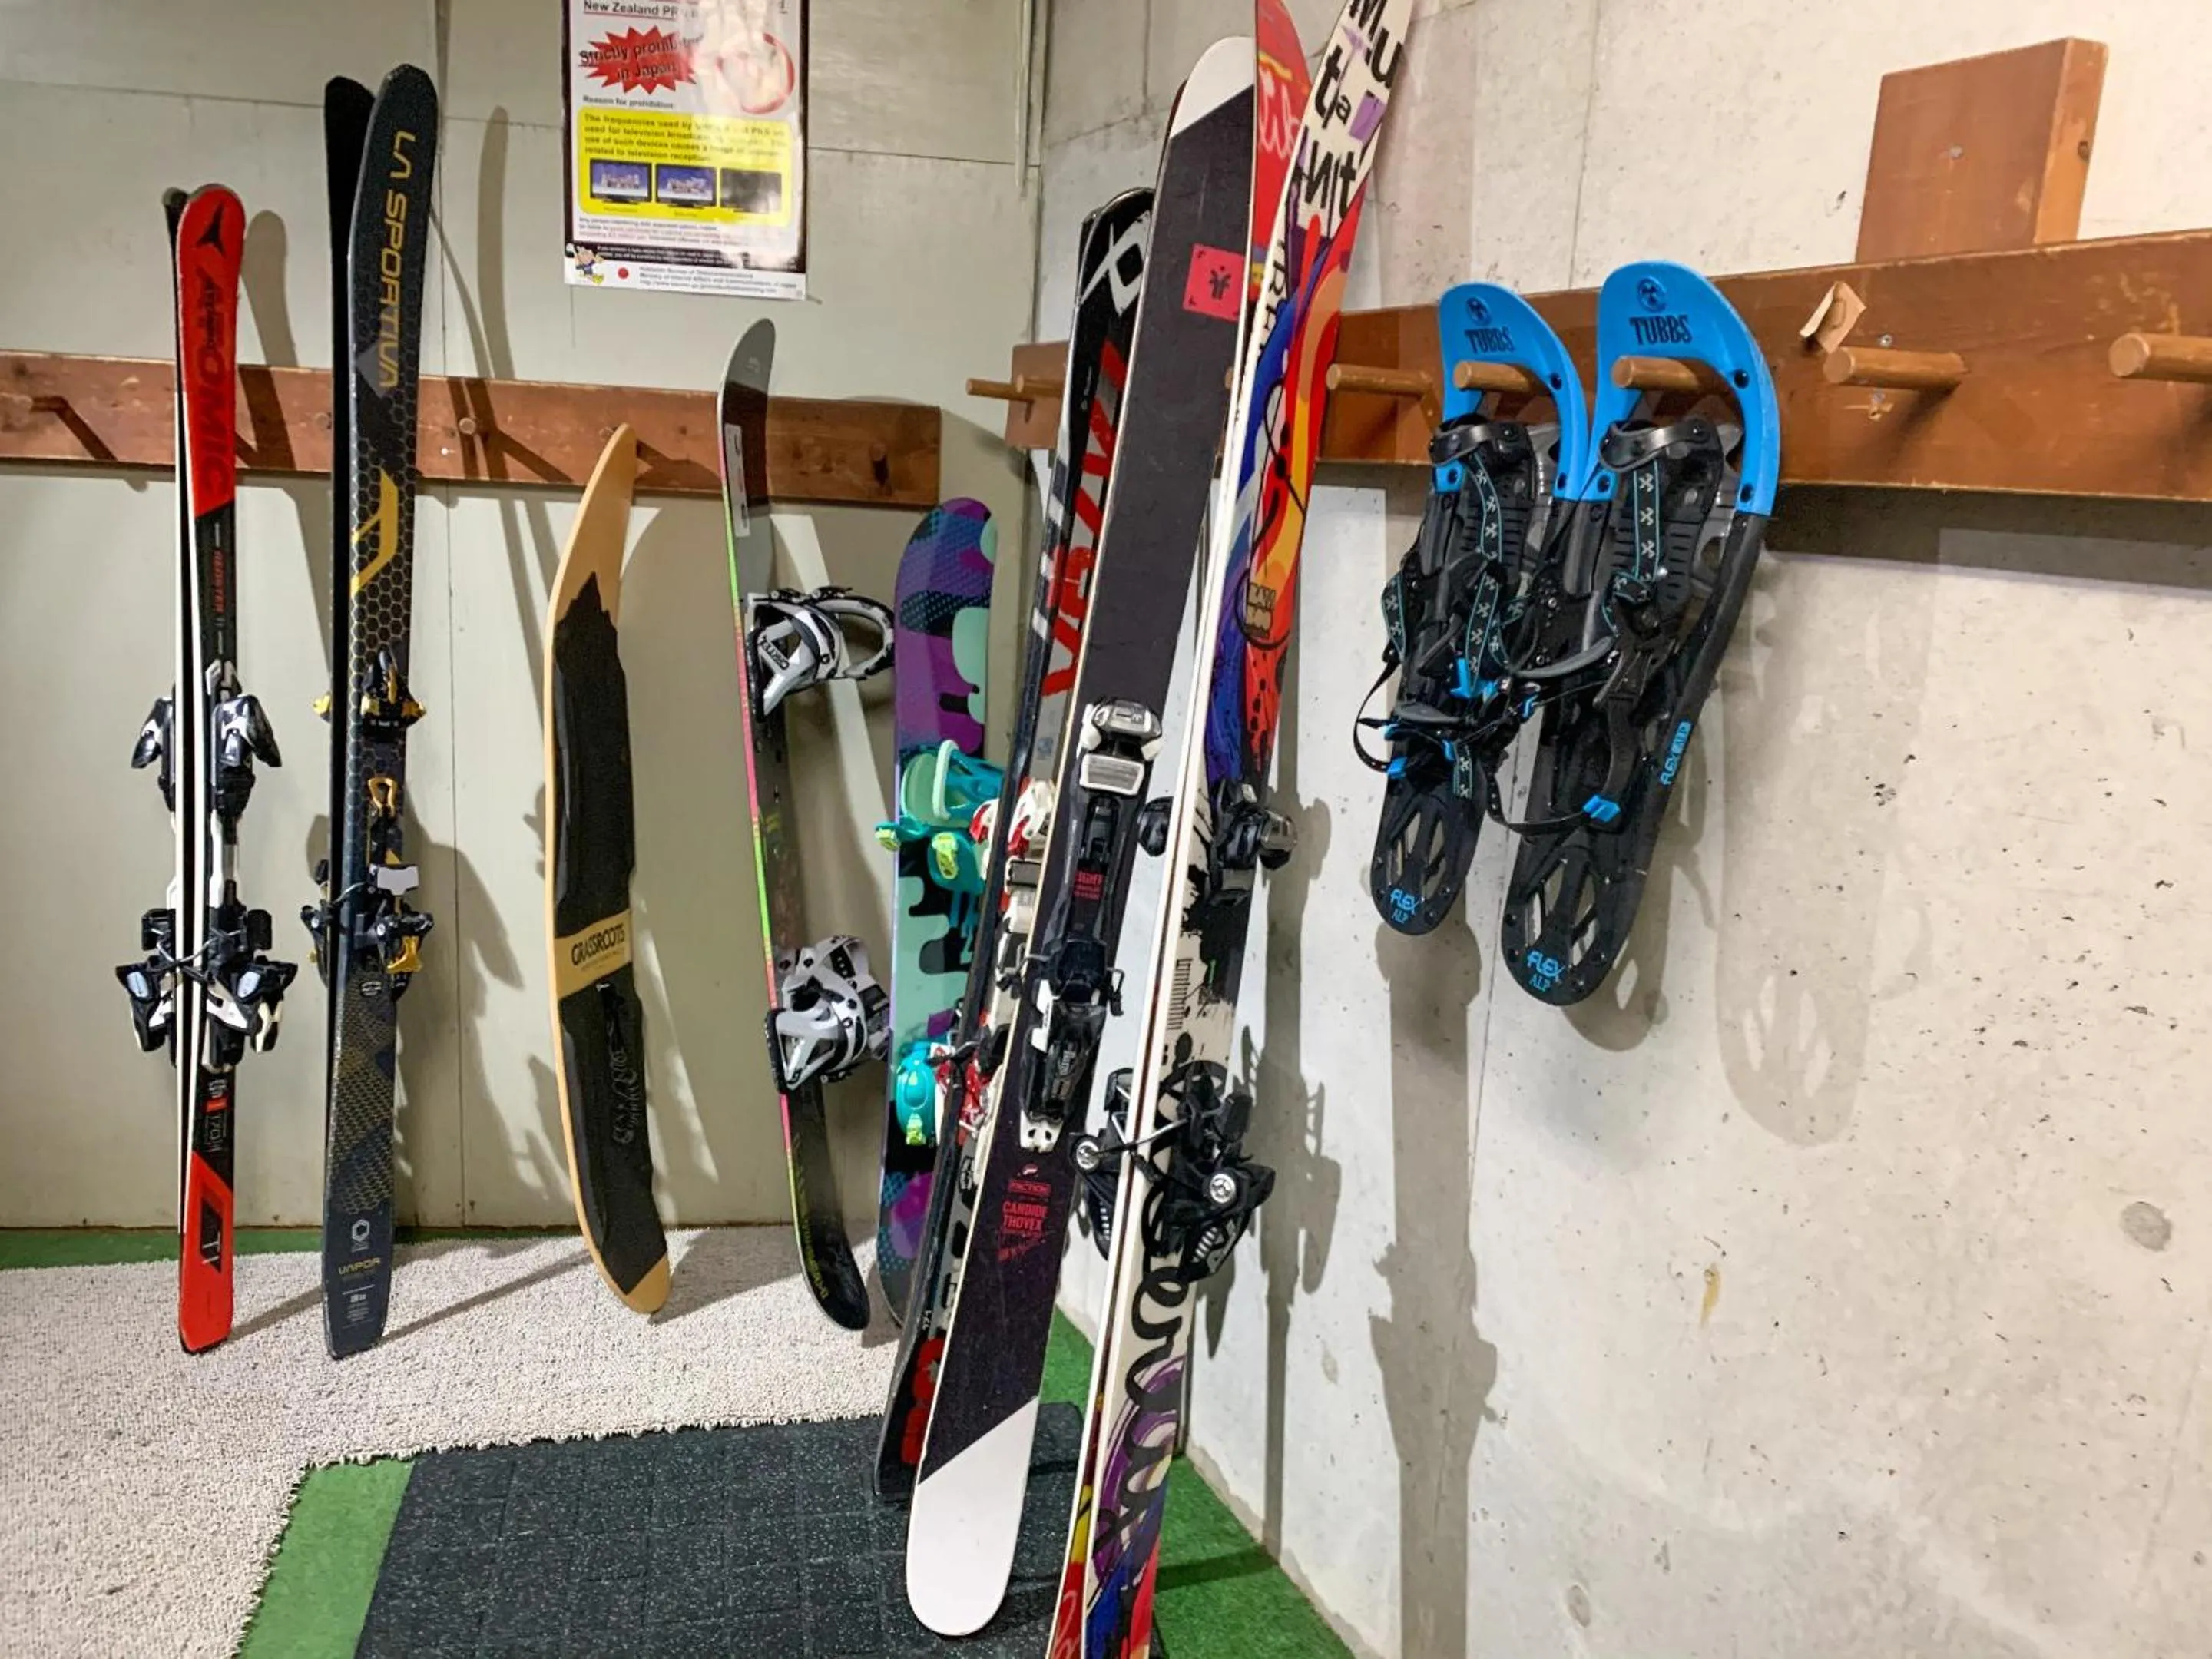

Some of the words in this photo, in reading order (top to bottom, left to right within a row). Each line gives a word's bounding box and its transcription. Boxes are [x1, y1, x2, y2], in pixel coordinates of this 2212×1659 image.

[584, 1, 609, 11] New
[612, 2, 659, 15] Zealand
[579, 46, 628, 64] Strictly
[616, 68, 629, 79] in
[634, 61, 677, 78] Japan
[390, 130, 416, 180] LA
[379, 190, 407, 389] SPORTIVA
[1465, 326, 1515, 353] TUBBS
[1629, 314, 1693, 346] TUBBS
[1390, 888, 1420, 915] FLEX
[1391, 909, 1409, 924] ALP
[571, 922, 625, 966] GRASSROOTS
[1527, 951, 1565, 982] FLEX
[1529, 974, 1551, 992] ALP
